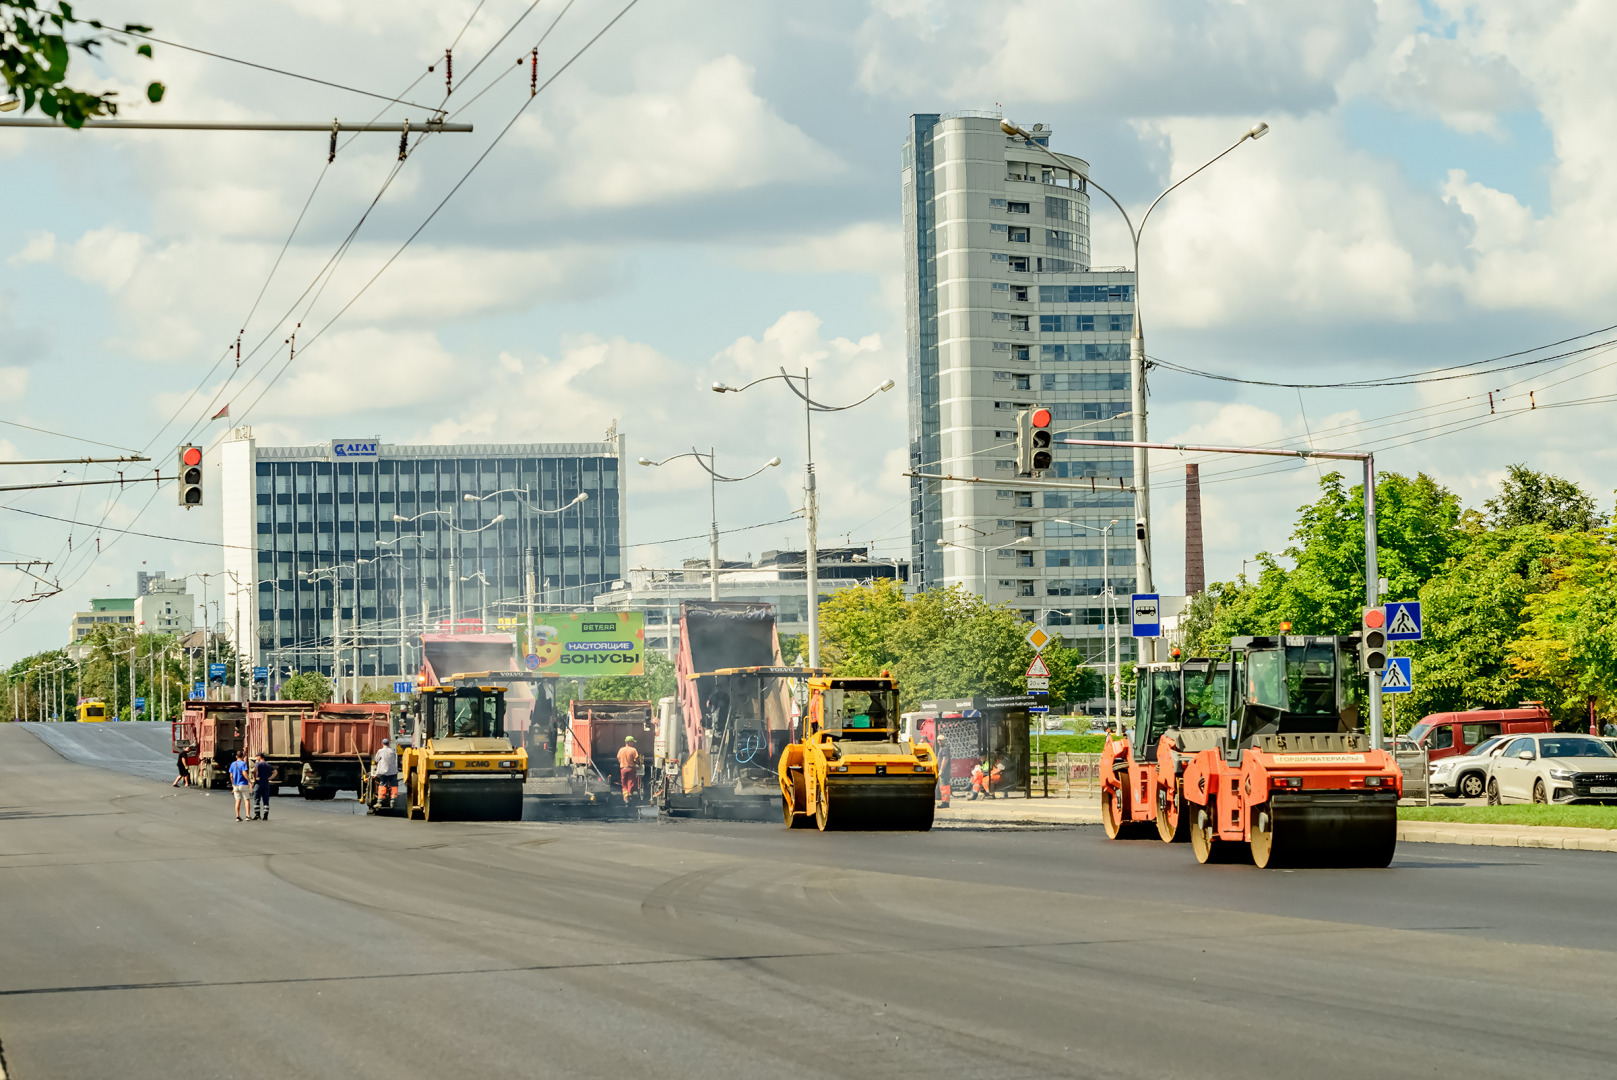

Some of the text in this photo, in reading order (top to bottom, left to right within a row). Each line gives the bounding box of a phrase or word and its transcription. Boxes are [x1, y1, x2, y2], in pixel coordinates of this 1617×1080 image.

[346, 443, 377, 451] АГАТ
[568, 642, 630, 650] НАСТОЯЩИЕ
[560, 653, 640, 664] БОНУСЫ
[465, 760, 491, 768] XCMG
